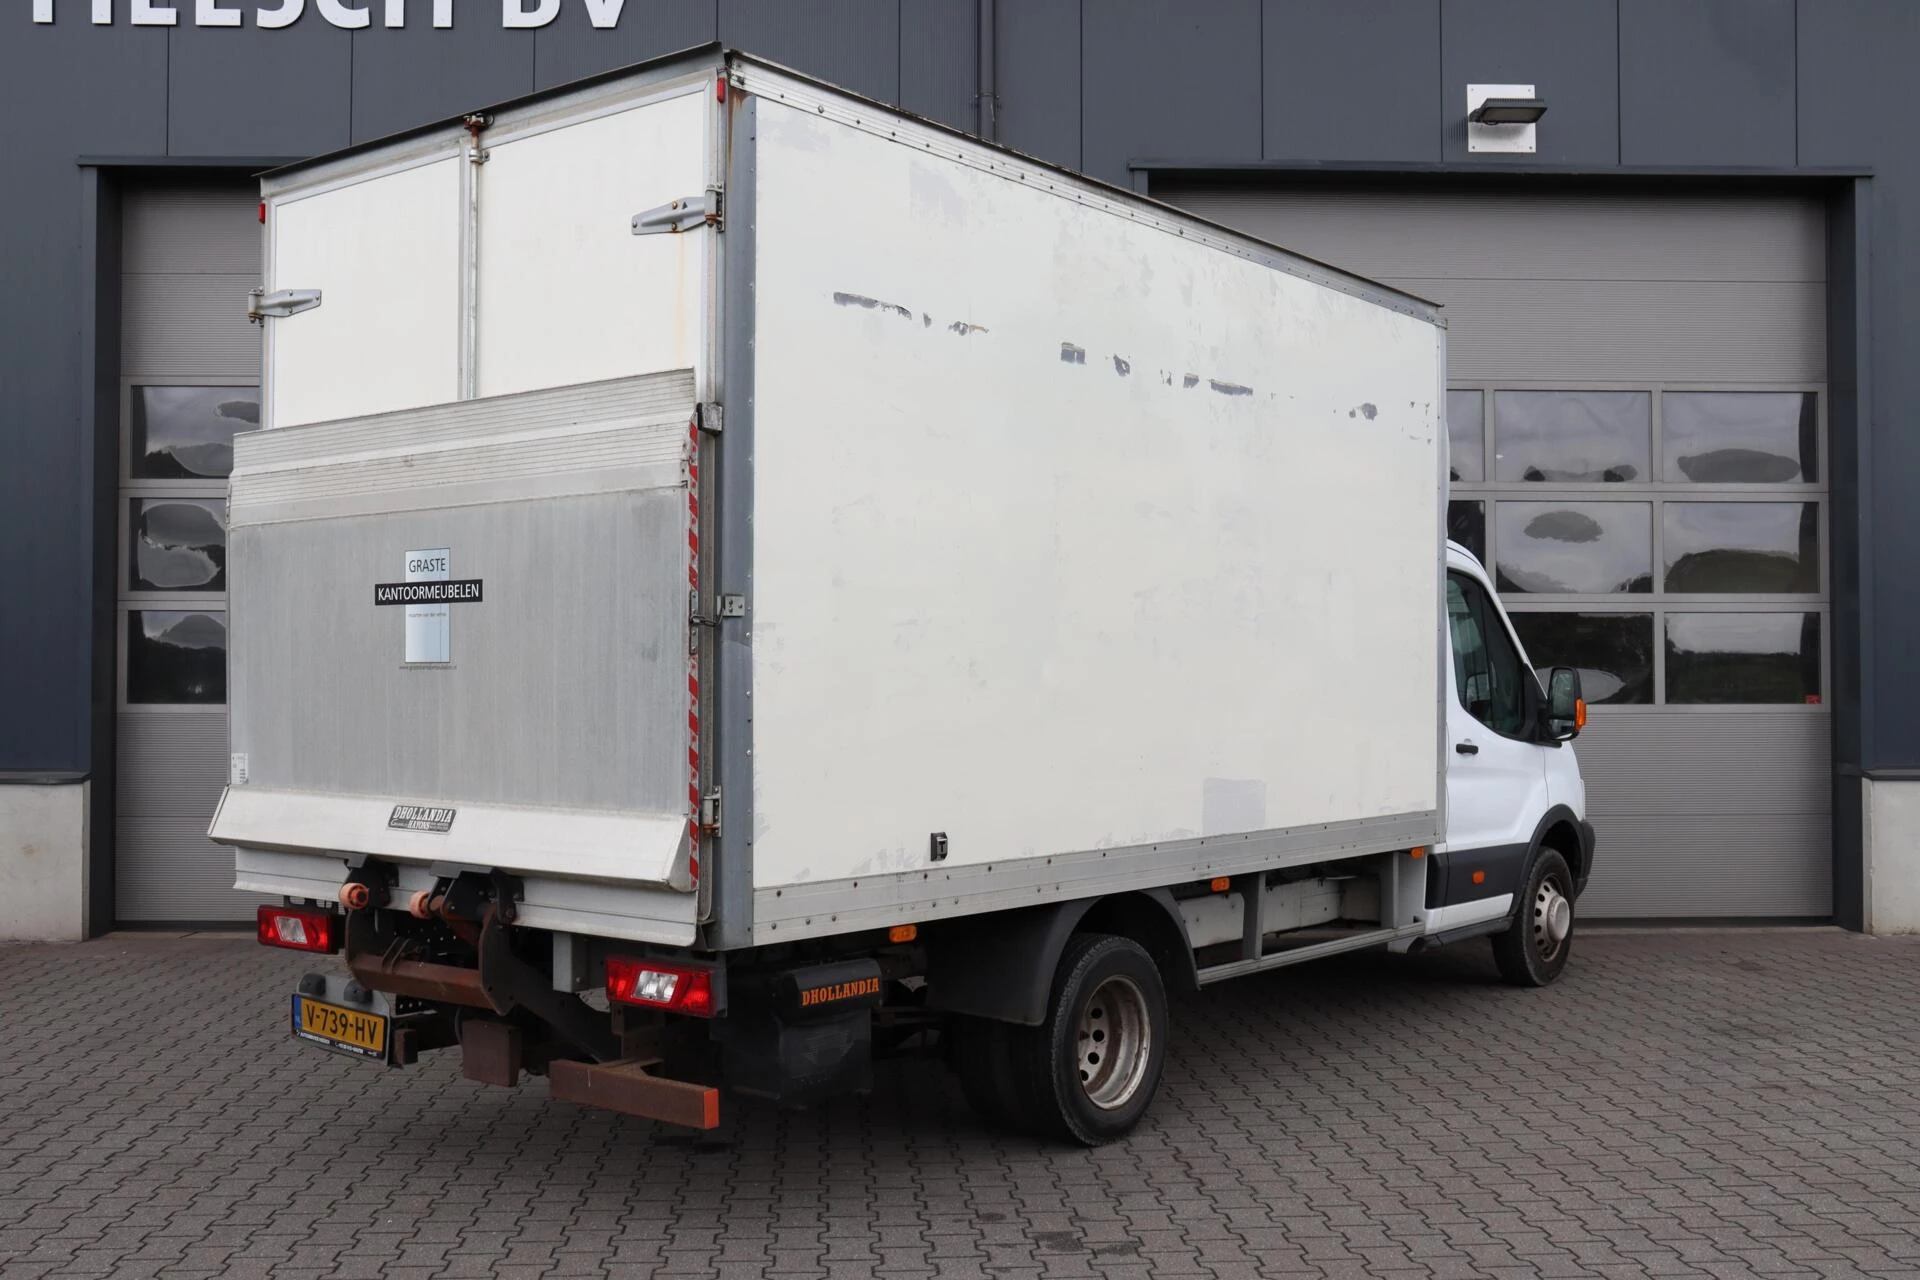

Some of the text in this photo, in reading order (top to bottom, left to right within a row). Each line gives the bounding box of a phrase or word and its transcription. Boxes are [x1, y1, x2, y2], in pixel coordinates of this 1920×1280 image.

[408, 558, 447, 573] GRASTE
[378, 583, 479, 601] KANTOORMEUBELEN
[393, 806, 454, 823] DHOLLANDIA
[802, 977, 880, 1007] DHOLLANDIA
[306, 1004, 377, 1045] V-739-HV
